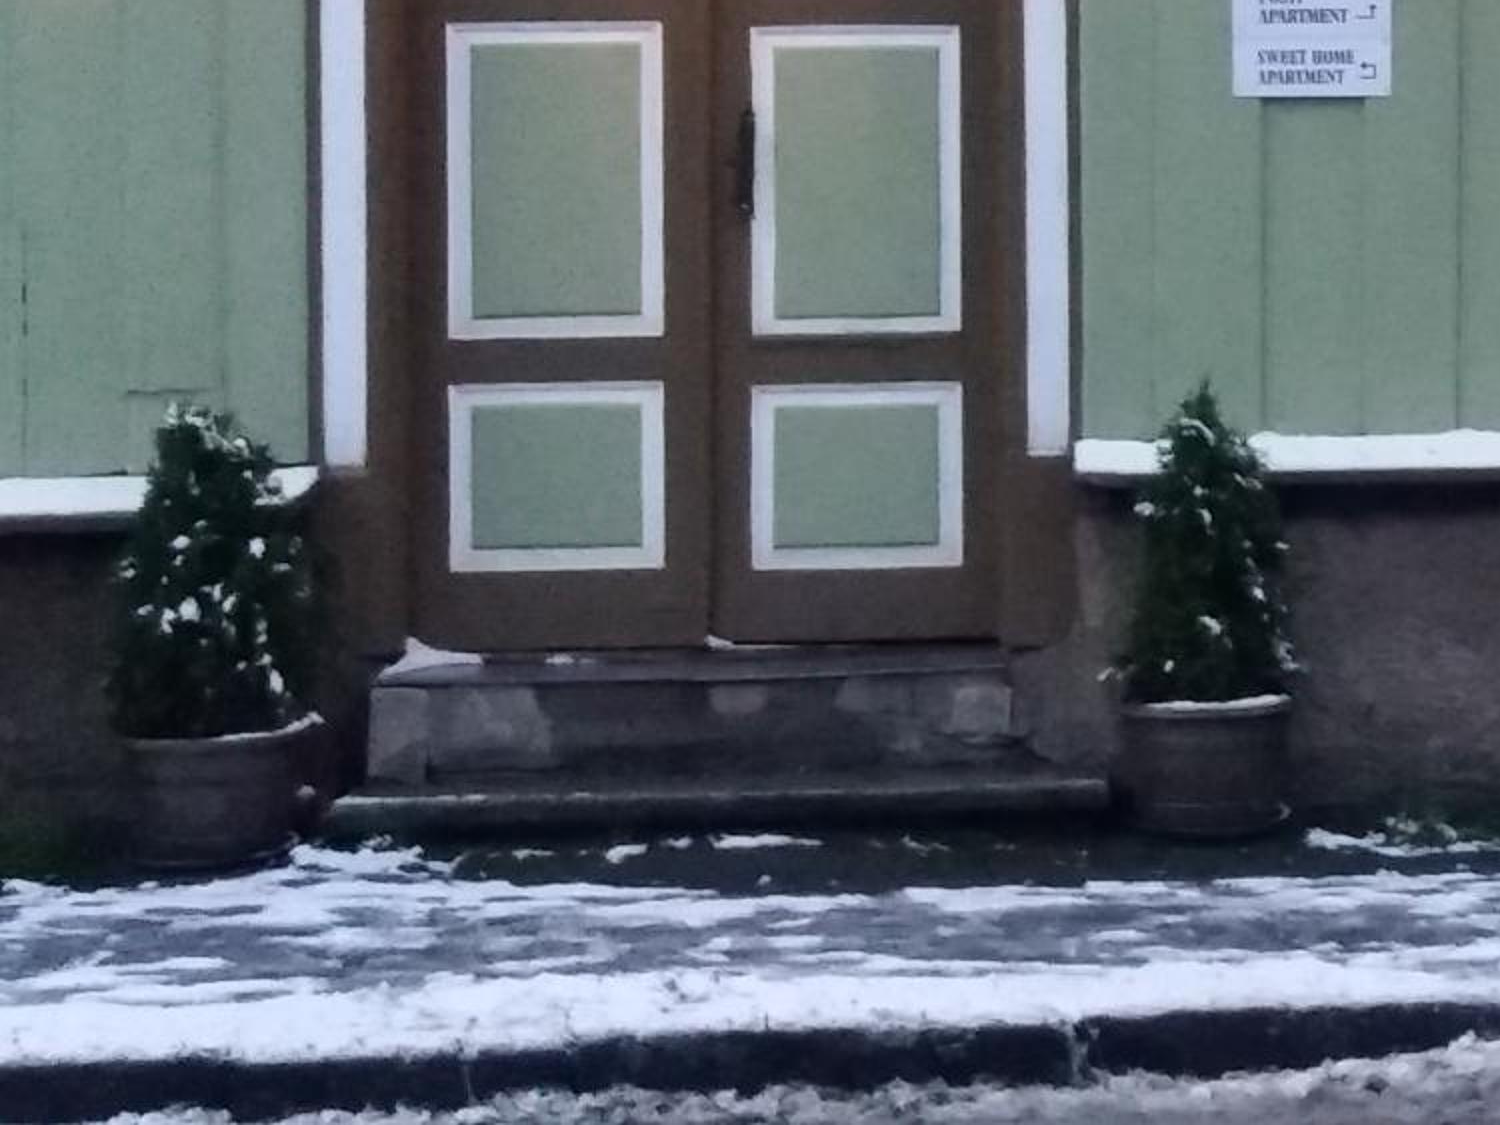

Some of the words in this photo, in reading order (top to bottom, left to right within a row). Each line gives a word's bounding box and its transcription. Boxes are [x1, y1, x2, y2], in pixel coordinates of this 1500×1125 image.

[1258, 8, 1348, 24] APARTMENT
[1257, 49, 1306, 65] SWEET
[1312, 49, 1356, 65] HOME
[1258, 69, 1344, 85] APARTMENT
